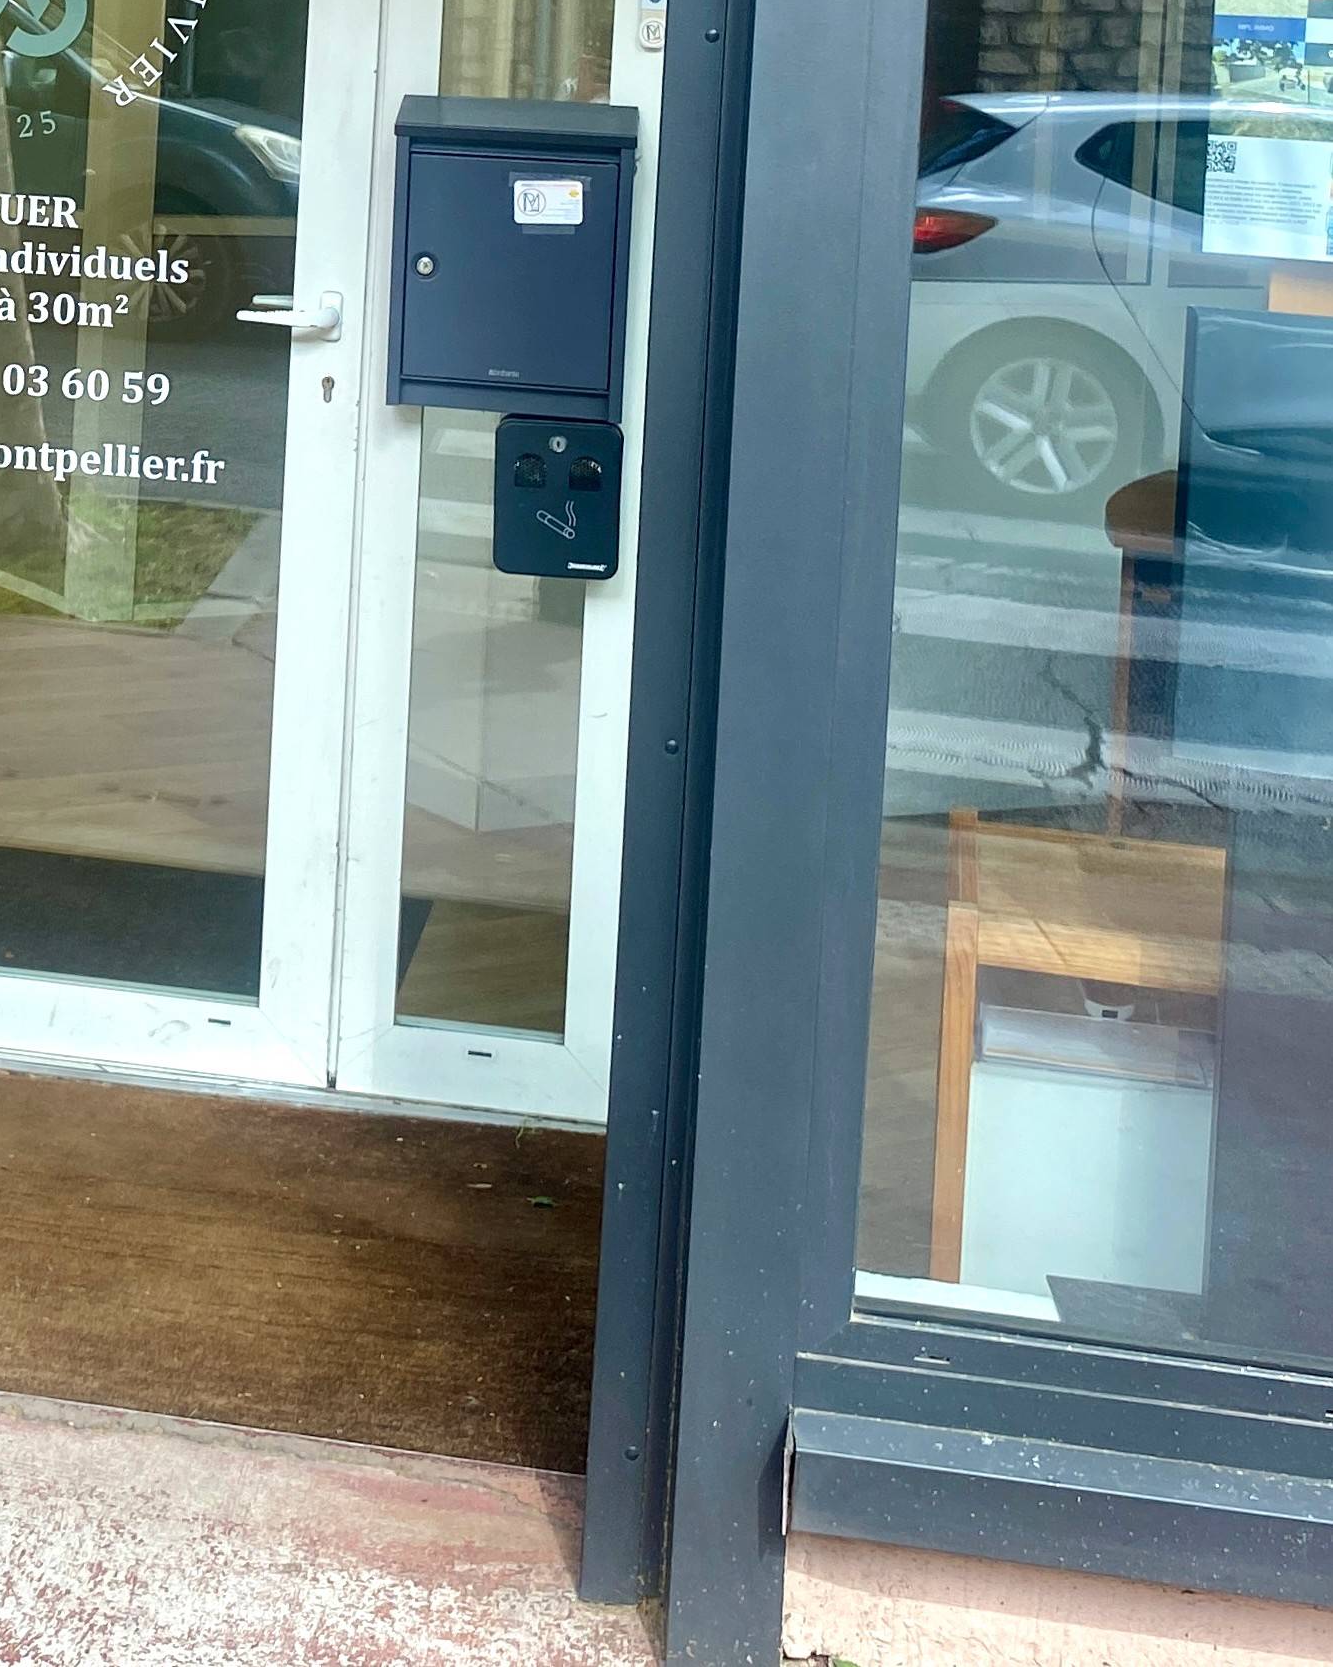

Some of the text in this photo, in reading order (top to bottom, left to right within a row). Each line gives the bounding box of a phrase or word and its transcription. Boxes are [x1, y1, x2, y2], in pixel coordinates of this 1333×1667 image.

[17, 110, 57, 138] 25
[27, 290, 130, 329] 30m²
[2, 363, 49, 398] 03
[61, 367, 110, 402] 60
[121, 370, 171, 406] 59
